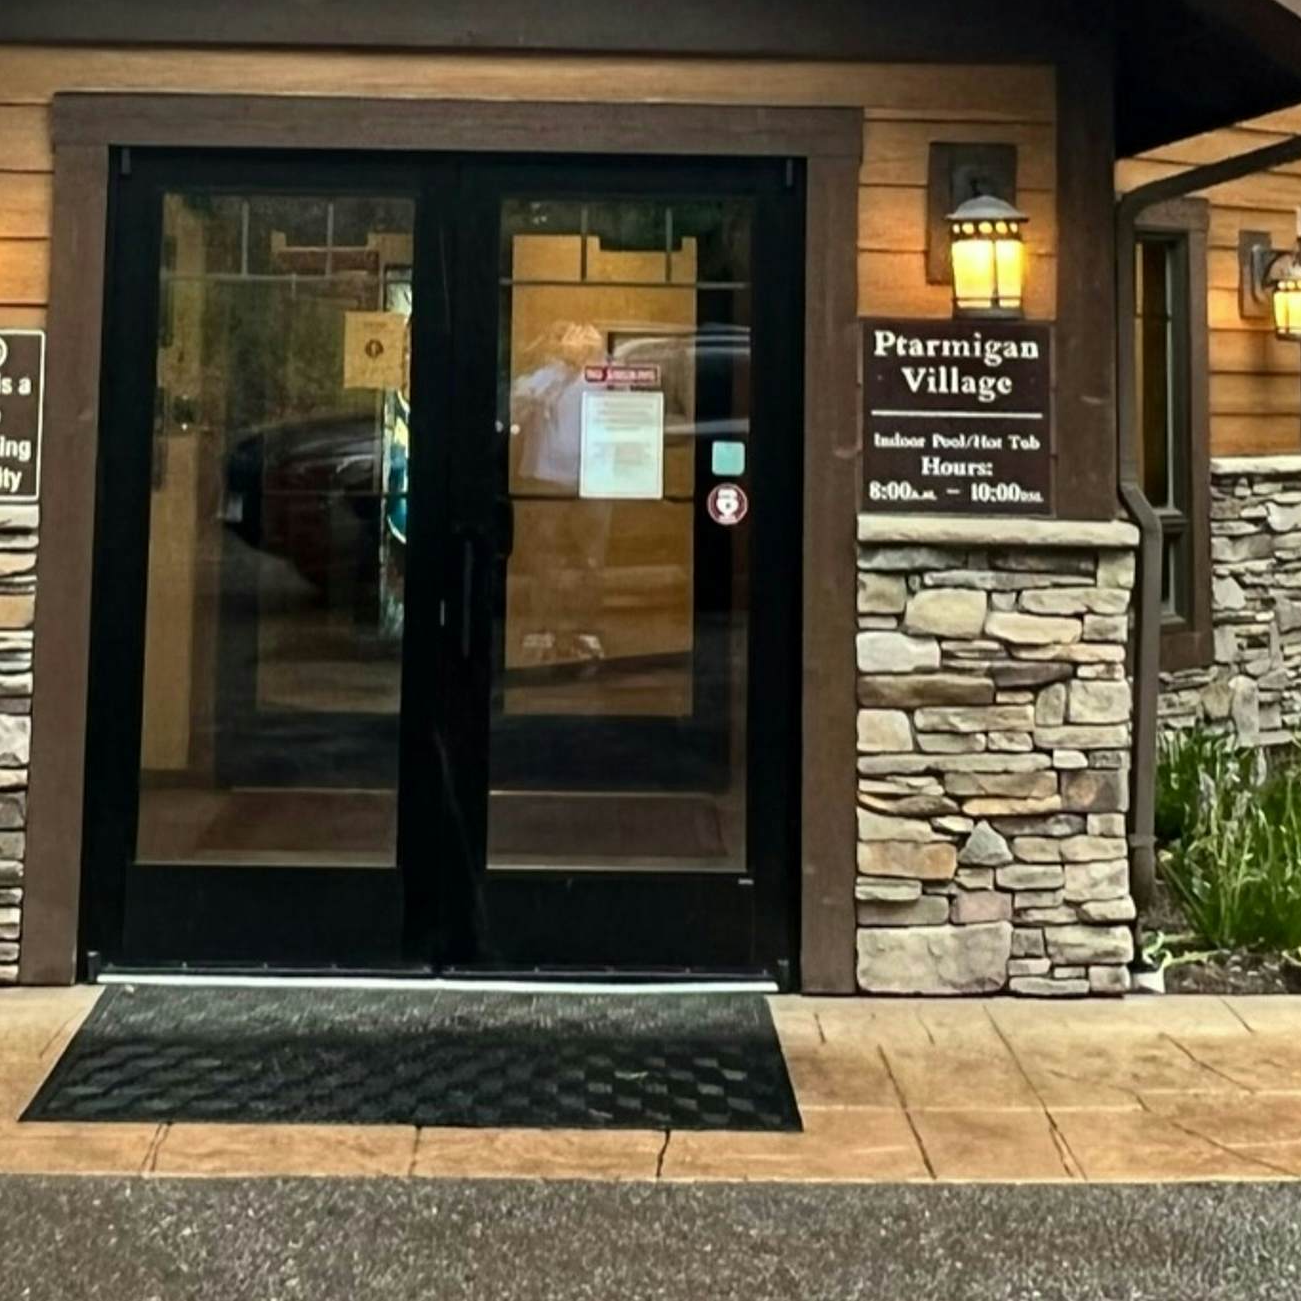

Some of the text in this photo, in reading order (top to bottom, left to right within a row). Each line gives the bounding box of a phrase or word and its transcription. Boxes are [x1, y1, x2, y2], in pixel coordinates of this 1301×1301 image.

[873, 330, 1039, 367] Ptarmigan
[17, 378, 32, 396] a
[901, 365, 1013, 403] Village
[873, 432, 926, 449] Indoor
[1008, 434, 1041, 450] Tub
[921, 456, 994, 477] Hours:
